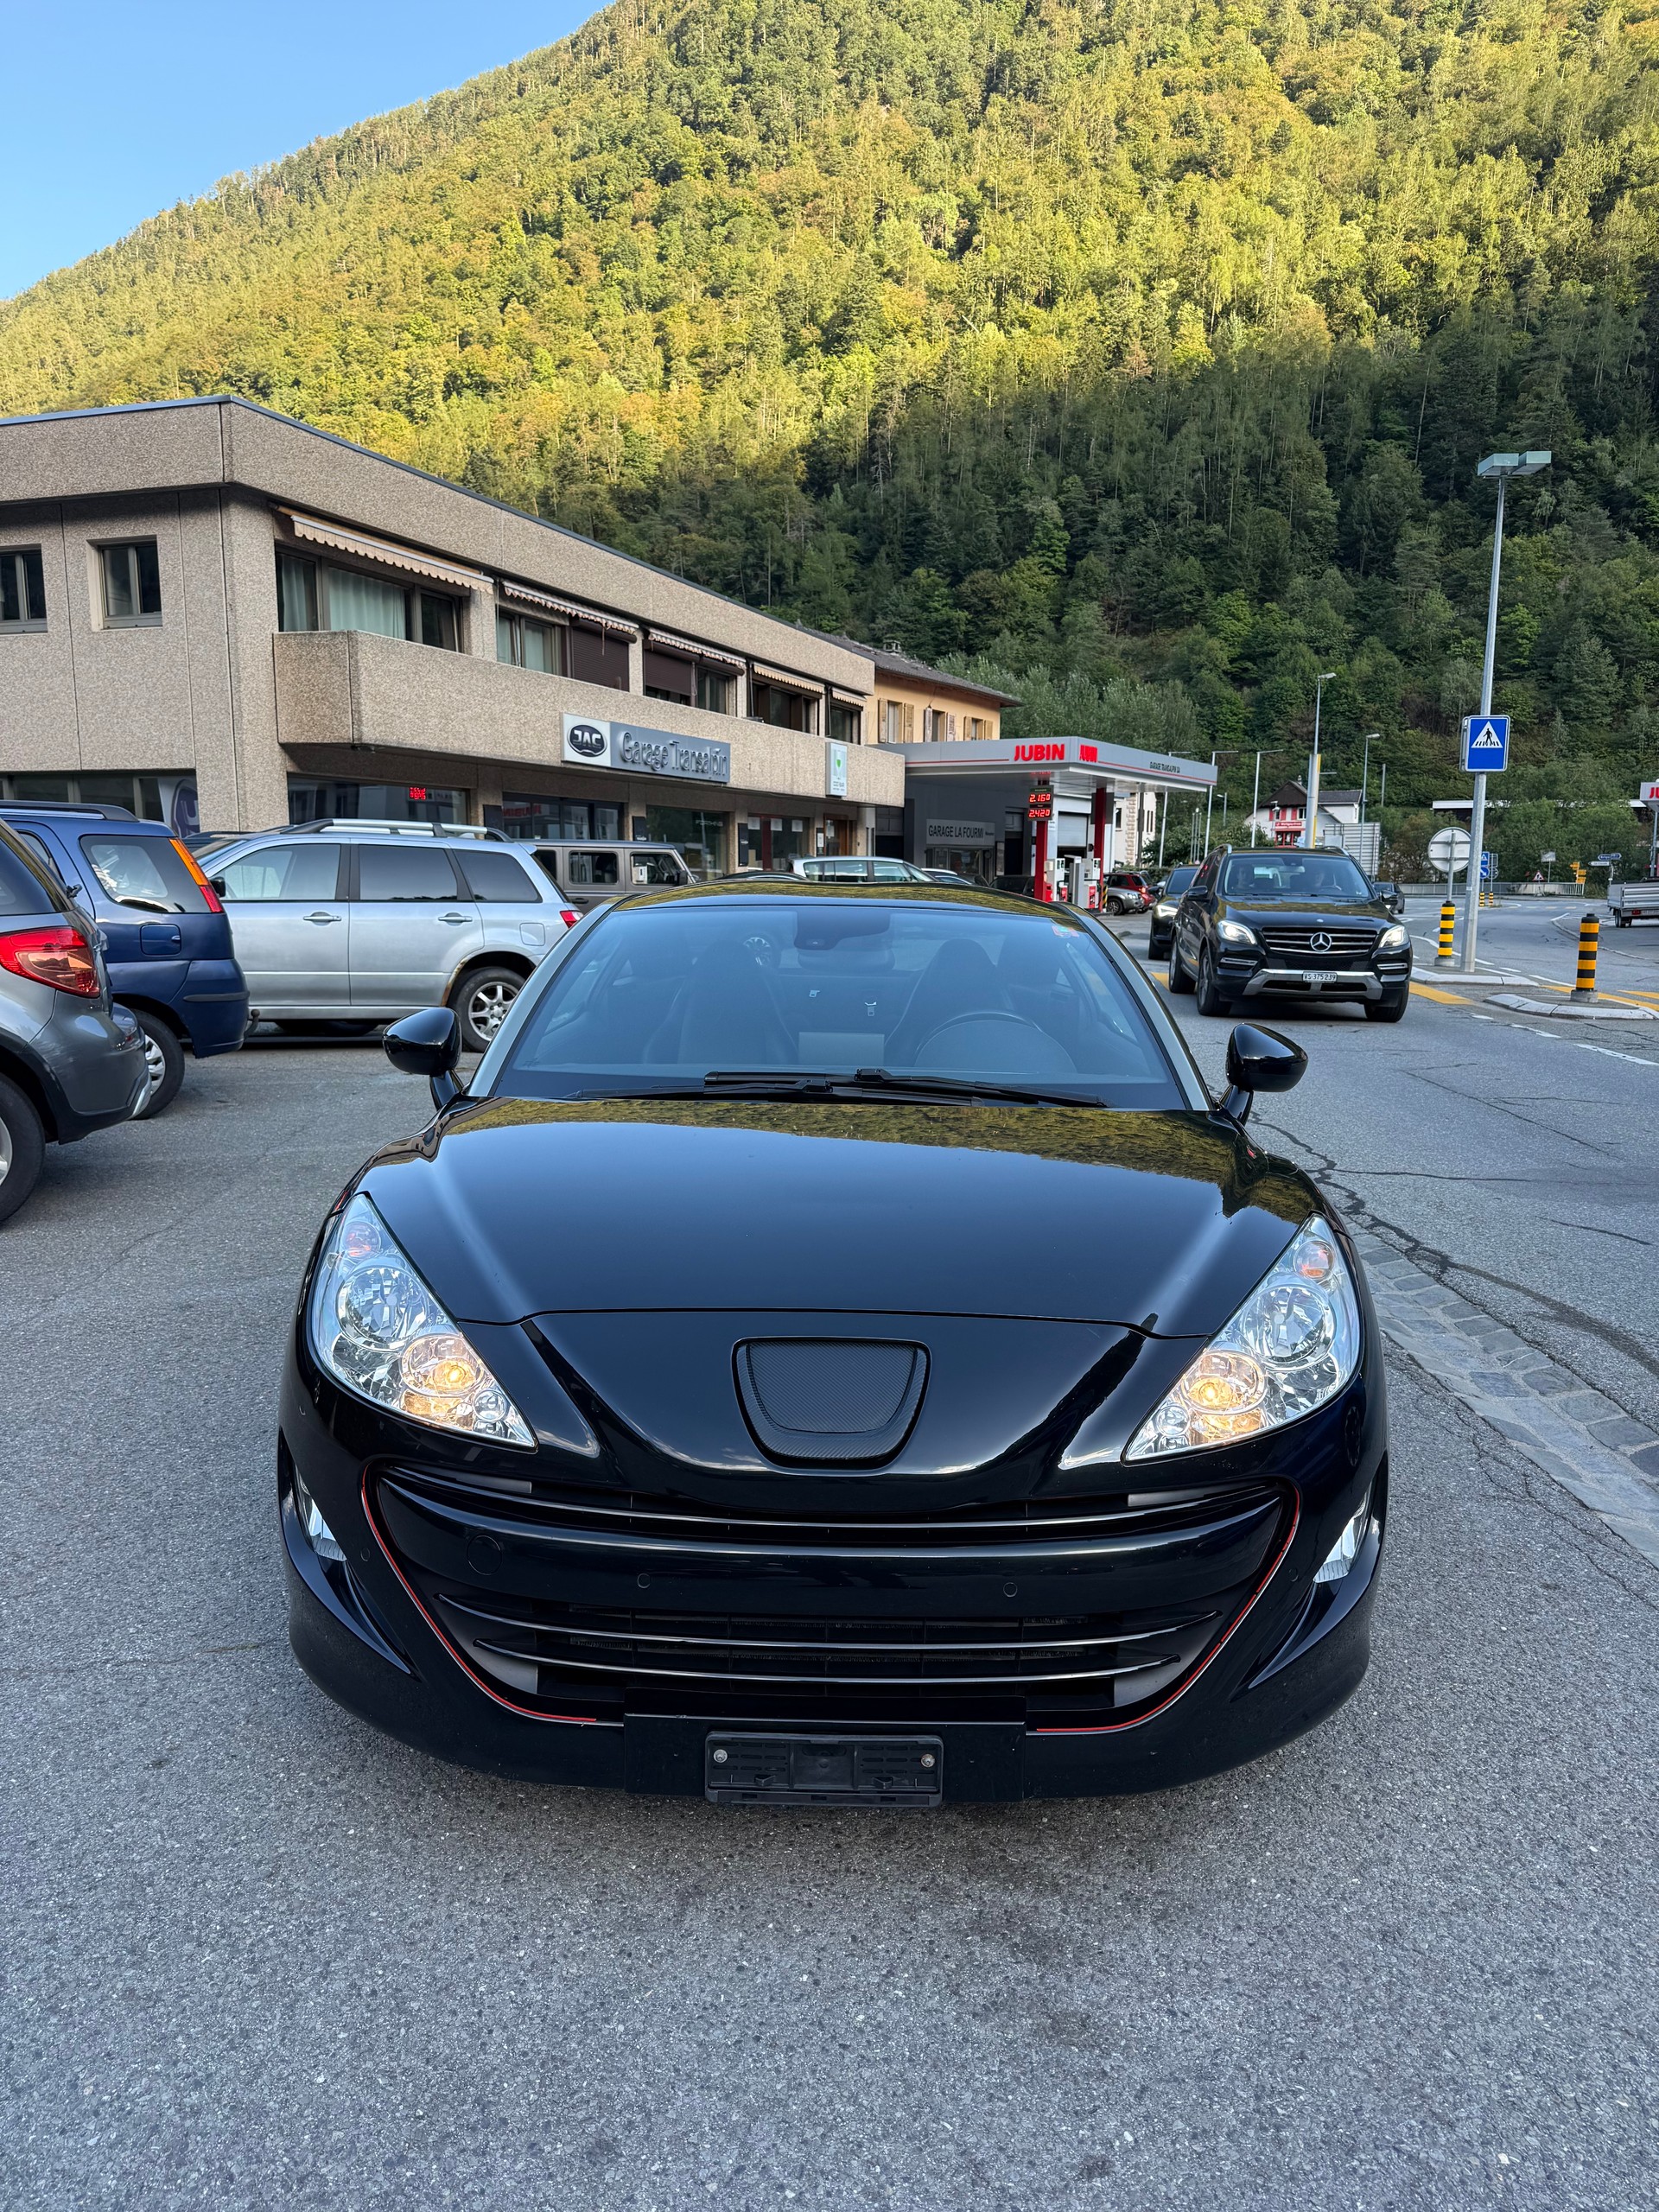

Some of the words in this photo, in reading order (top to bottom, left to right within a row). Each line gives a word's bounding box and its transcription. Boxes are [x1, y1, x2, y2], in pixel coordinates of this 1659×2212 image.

[572, 728, 601, 747] JAC
[620, 732, 669, 771] Garage
[669, 741, 728, 779] Transalpin
[1014, 743, 1065, 762] JUBIN
[1079, 744, 1098, 763] JUBIN
[928, 824, 954, 837] GARAGE
[954, 826, 963, 838] LA
[963, 826, 984, 839] FOURMI
